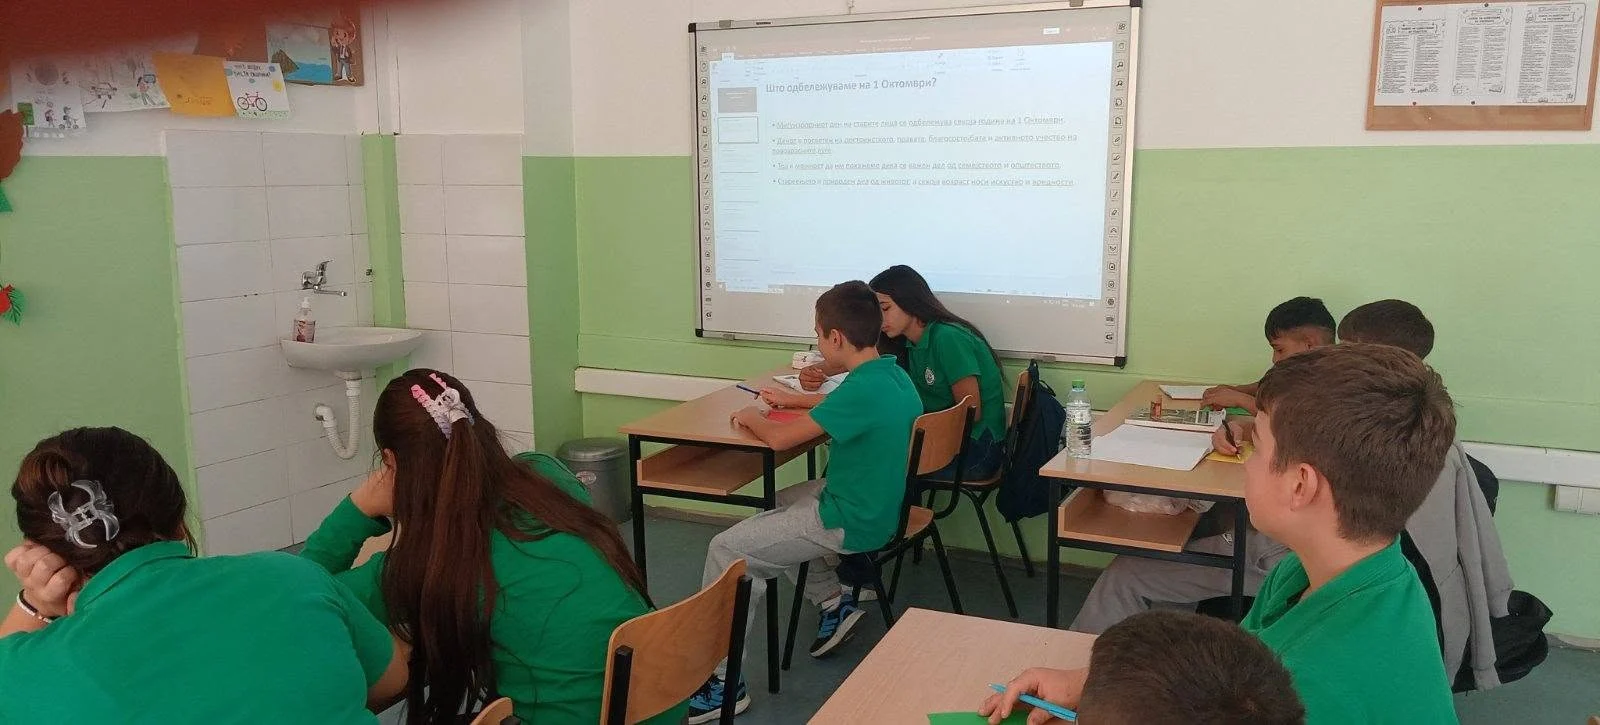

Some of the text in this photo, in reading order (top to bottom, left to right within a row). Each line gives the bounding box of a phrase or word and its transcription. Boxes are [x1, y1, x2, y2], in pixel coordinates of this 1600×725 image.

[766, 77, 937, 94] Што одбележуваме на 1 Октомври?
